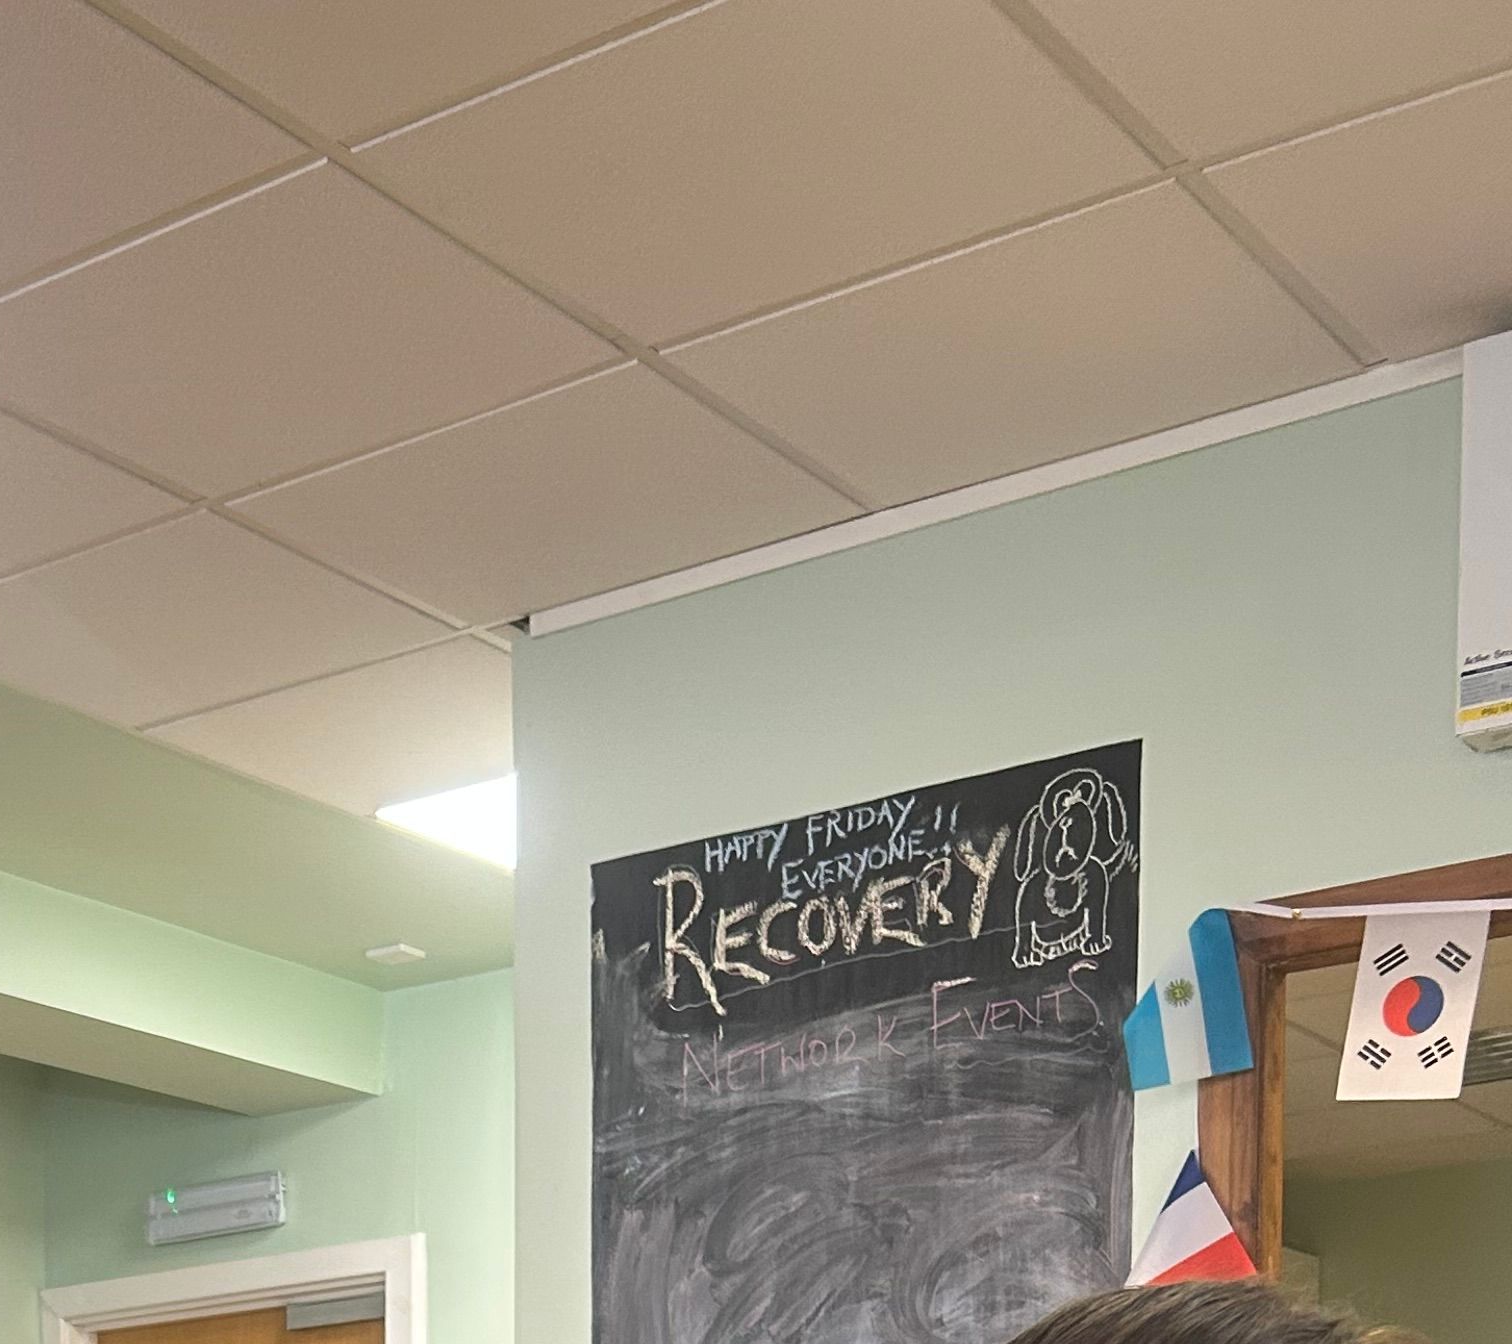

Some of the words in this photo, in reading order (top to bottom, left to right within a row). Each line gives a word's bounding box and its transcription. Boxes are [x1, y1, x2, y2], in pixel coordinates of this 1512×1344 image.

[704, 822, 788, 873] HAPPY
[806, 795, 916, 855] FRIDAY
[653, 824, 1011, 1016] RECOVERY
[683, 1014, 907, 1097] NETWORK
